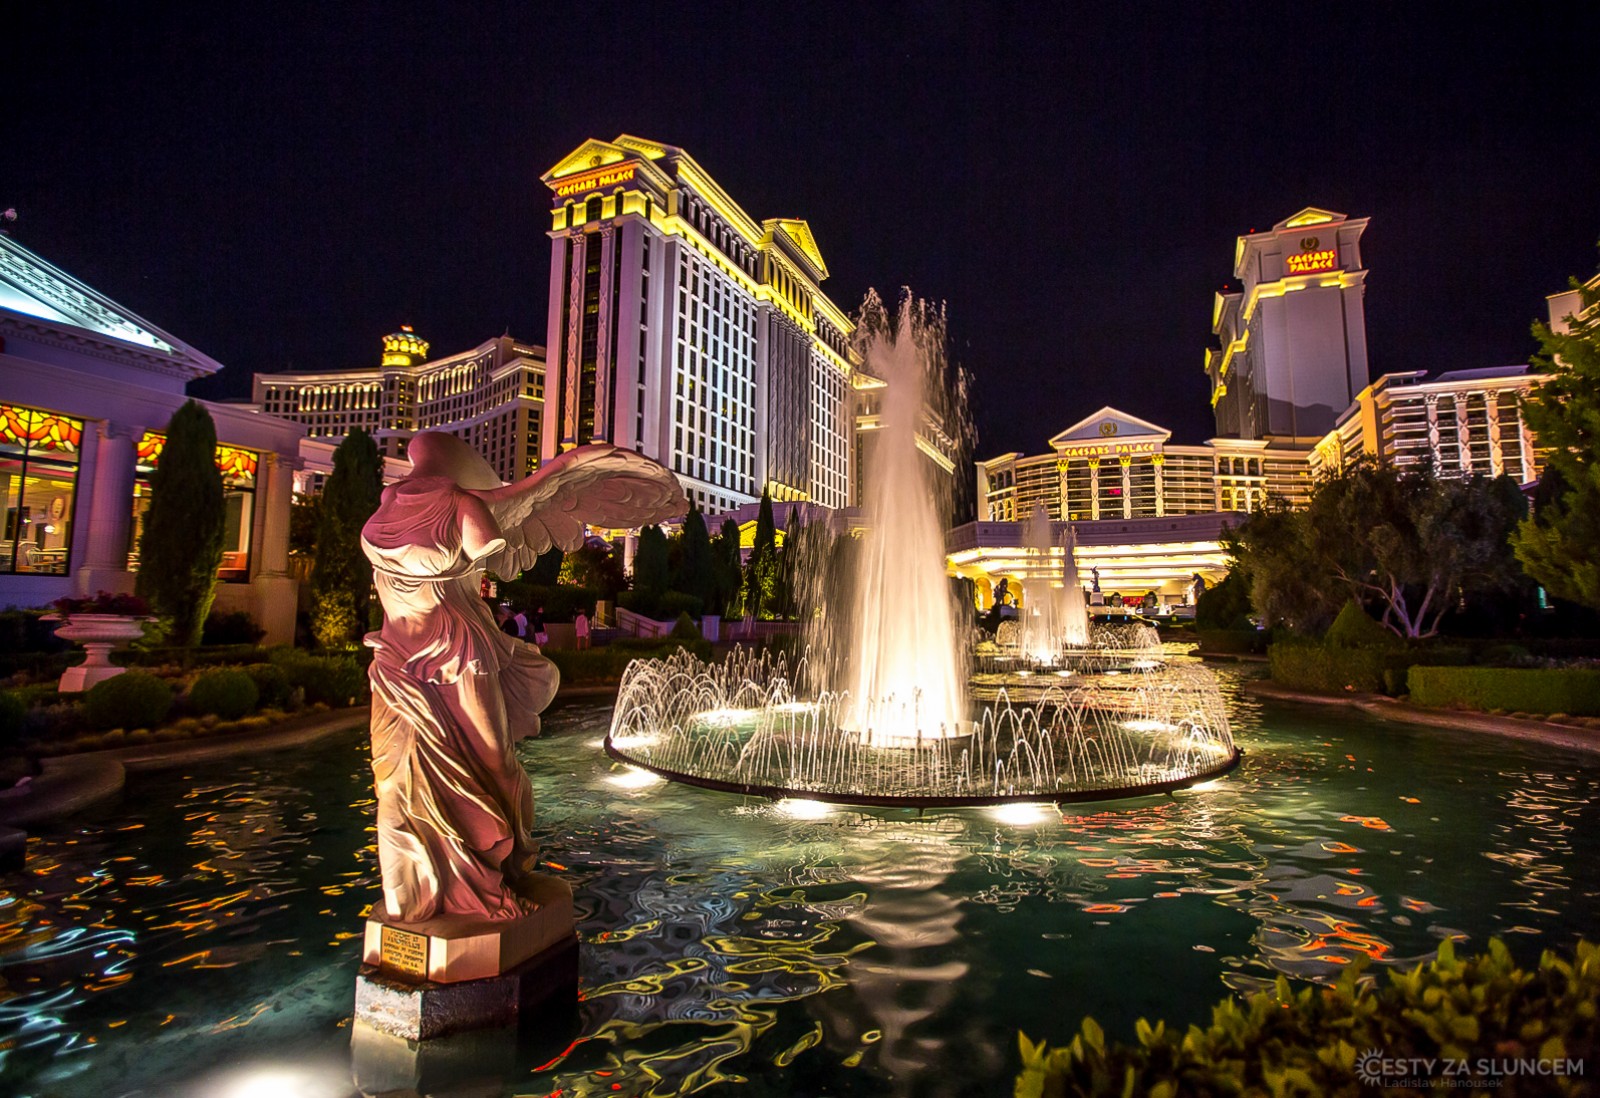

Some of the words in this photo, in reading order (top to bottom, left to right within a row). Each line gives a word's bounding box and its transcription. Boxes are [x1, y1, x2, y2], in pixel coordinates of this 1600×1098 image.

[557, 179, 597, 197] CAESARS
[599, 169, 634, 187] PALACE
[1286, 250, 1335, 264] CAESARS
[1290, 259, 1333, 273] PALACE
[1065, 445, 1110, 457] CAESARS
[1115, 443, 1155, 454] PALACE
